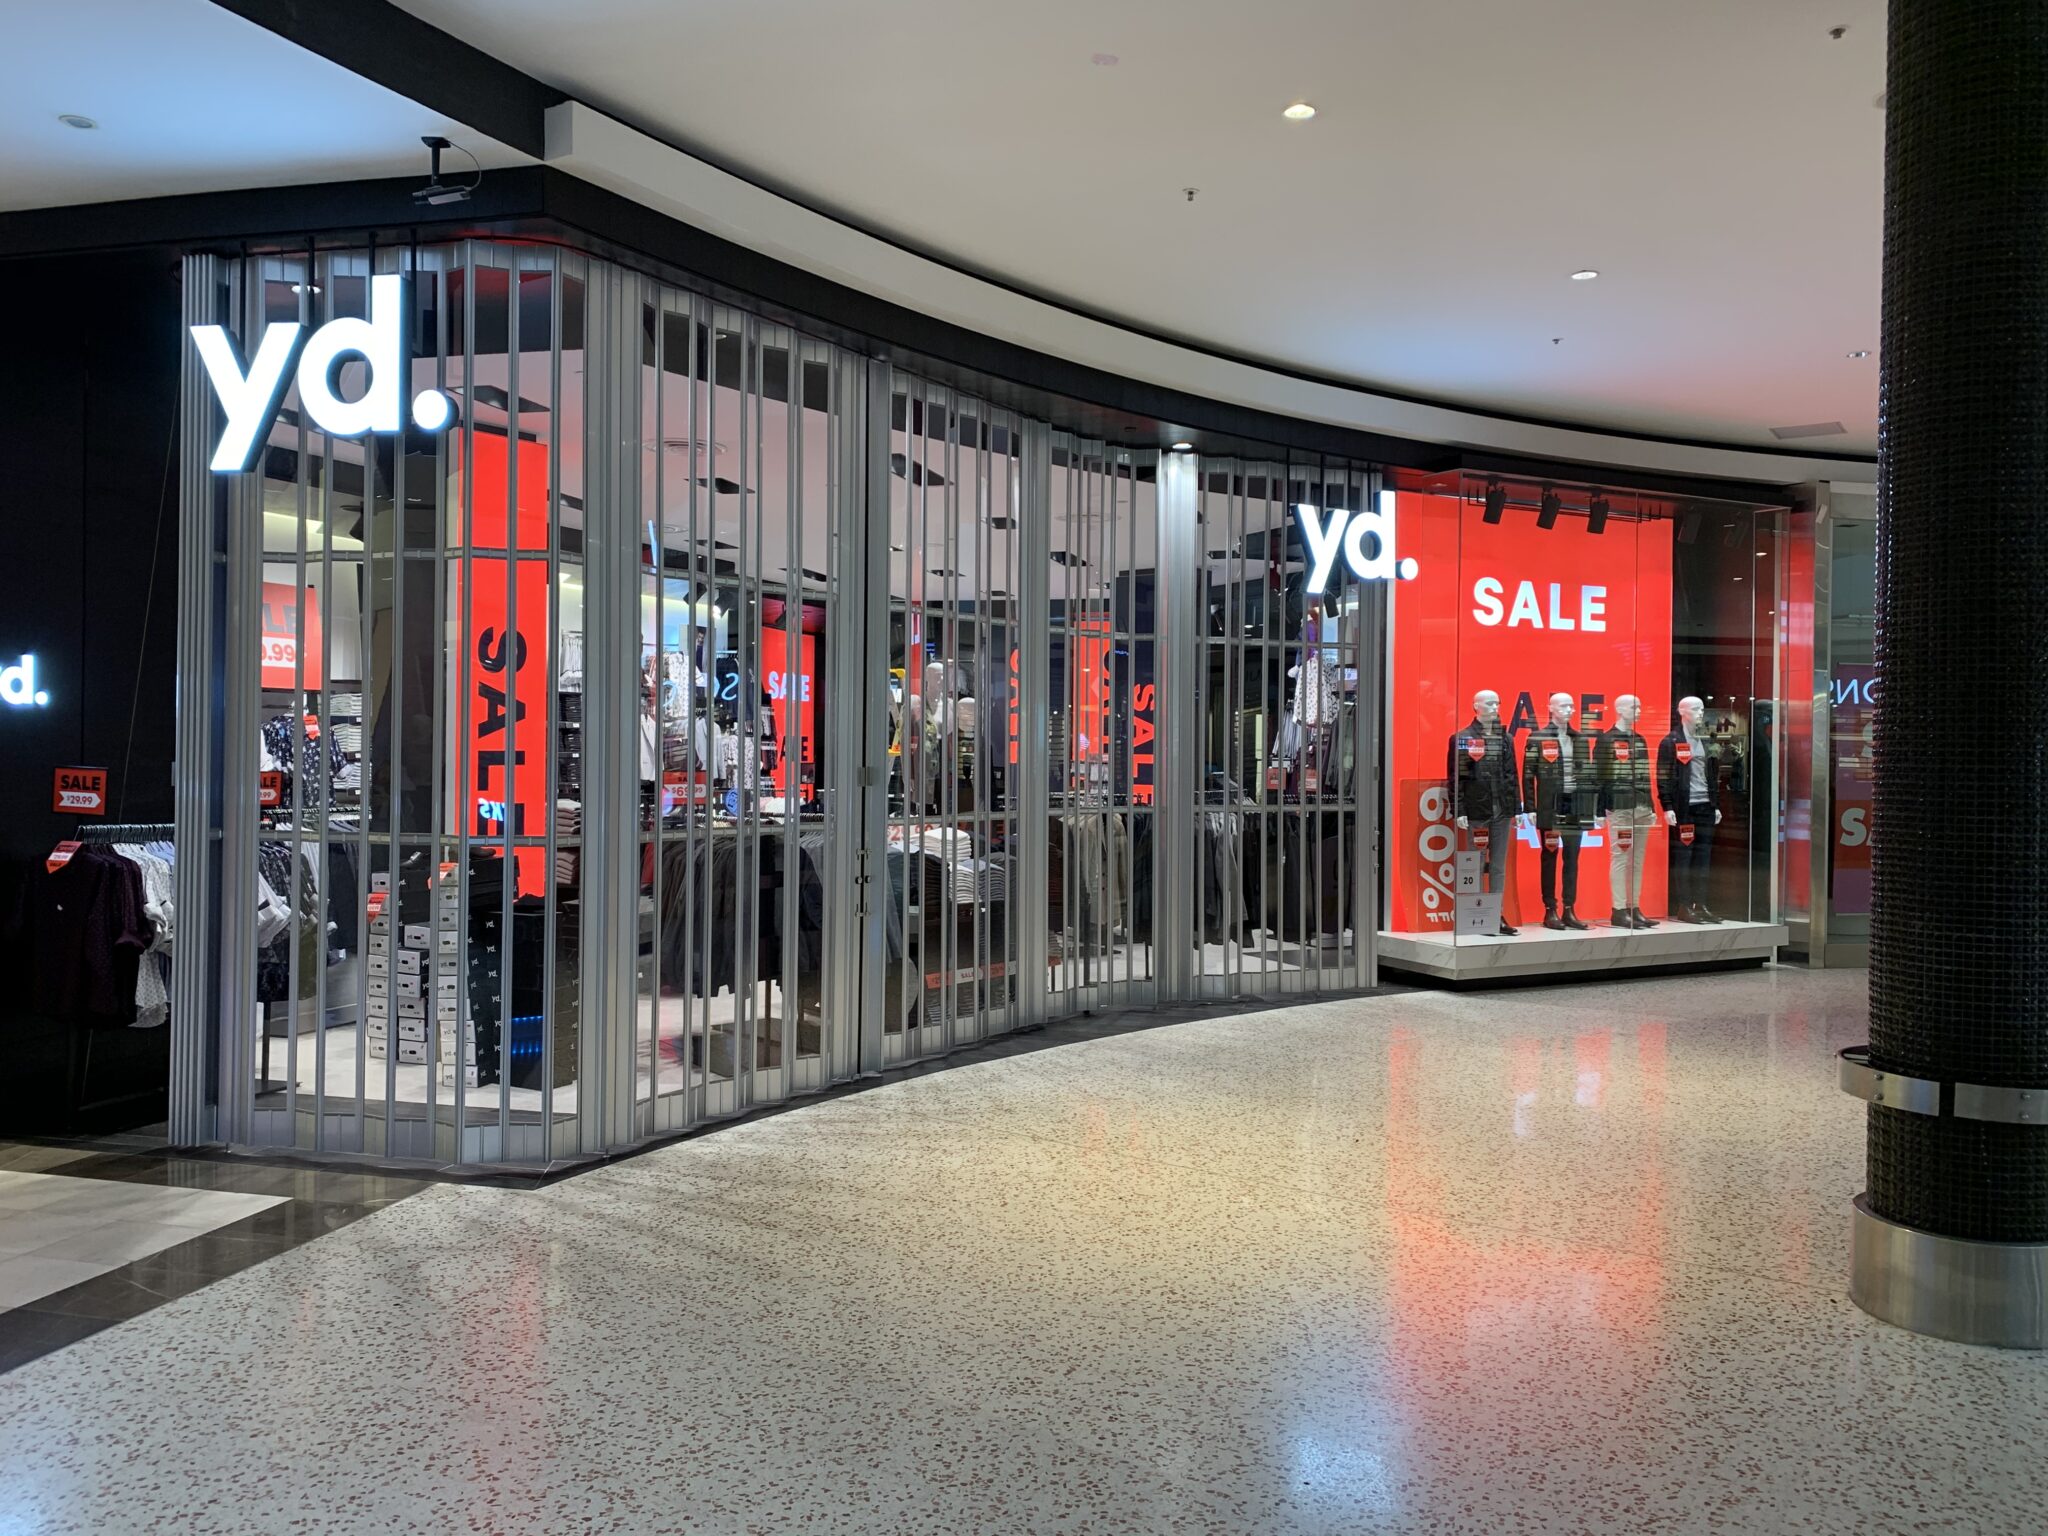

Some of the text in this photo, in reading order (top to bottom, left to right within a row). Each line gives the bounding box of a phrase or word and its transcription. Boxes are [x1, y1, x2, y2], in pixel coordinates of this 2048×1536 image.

[189, 274, 448, 471] yd.
[1298, 490, 1418, 594] yd.
[1472, 577, 1607, 632] SALE
[0, 654, 49, 704] d.
[477, 626, 527, 836] SALE
[61, 775, 101, 791] SALE
[1463, 876, 1474, 885] 20
